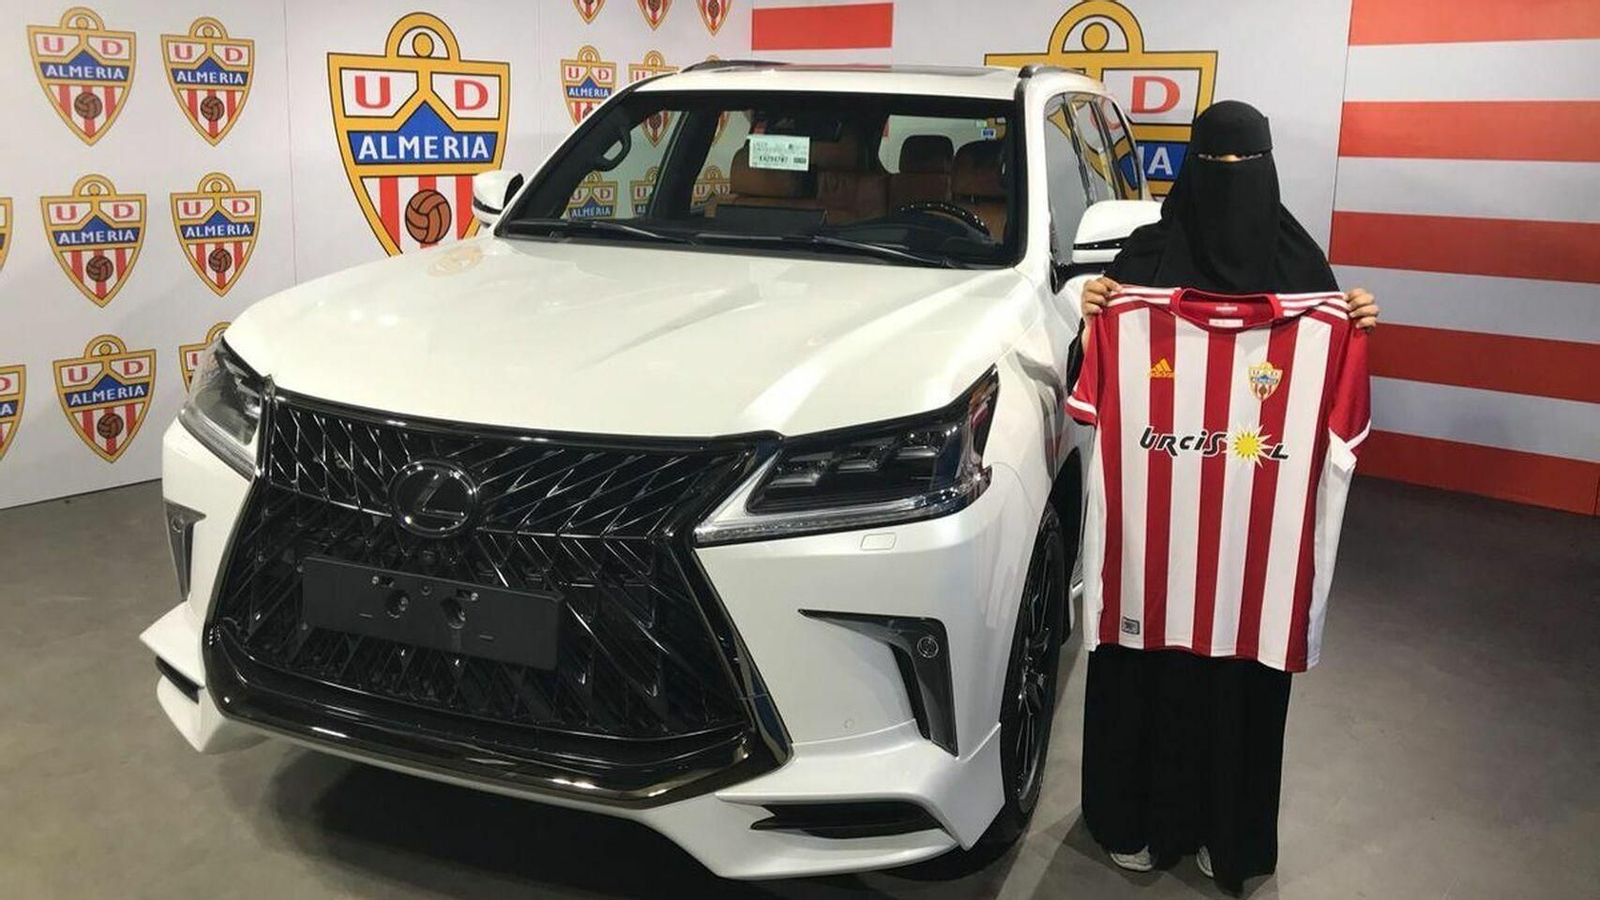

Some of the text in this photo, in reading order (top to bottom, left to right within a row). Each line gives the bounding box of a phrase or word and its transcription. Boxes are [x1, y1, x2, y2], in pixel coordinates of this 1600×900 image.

[43, 36, 123, 56] U D
[174, 45, 243, 62] U D
[45, 64, 125, 80] ALMERIA
[176, 70, 244, 85] ALMERIA
[568, 67, 609, 80] U D
[355, 75, 489, 111] U D
[568, 87, 610, 98] ALMERIA
[1131, 75, 1181, 114] D
[358, 135, 489, 160] ALMERIA
[56, 203, 134, 220] U D
[182, 199, 250, 216] U D
[58, 229, 136, 245] ALMERIA
[185, 223, 251, 239] ALMERIA
[67, 360, 143, 383] U D
[70, 385, 145, 405] ALMERIA
